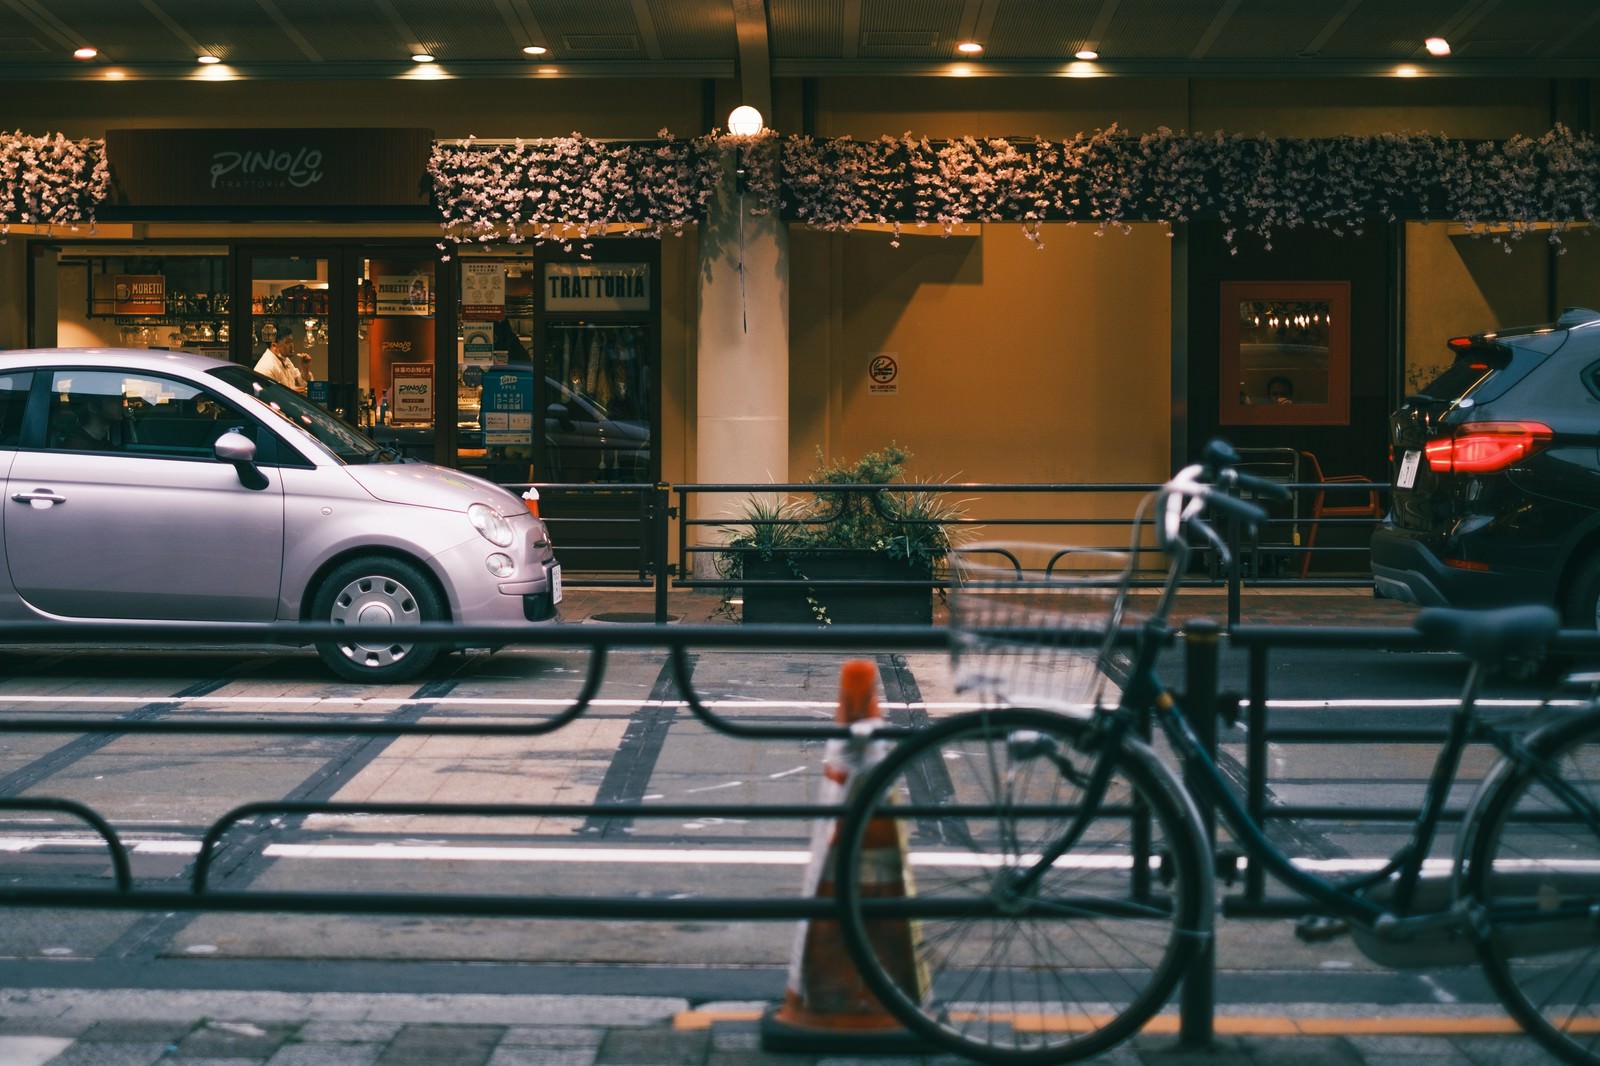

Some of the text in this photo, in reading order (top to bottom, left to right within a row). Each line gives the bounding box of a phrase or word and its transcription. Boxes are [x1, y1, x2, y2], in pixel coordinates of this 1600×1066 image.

[210, 147, 324, 188] PINOLO
[132, 283, 162, 294] MORETTI
[379, 284, 409, 293] MORETTI
[548, 276, 644, 298] TRATTORIA
[399, 384, 428, 395] PINOLO
